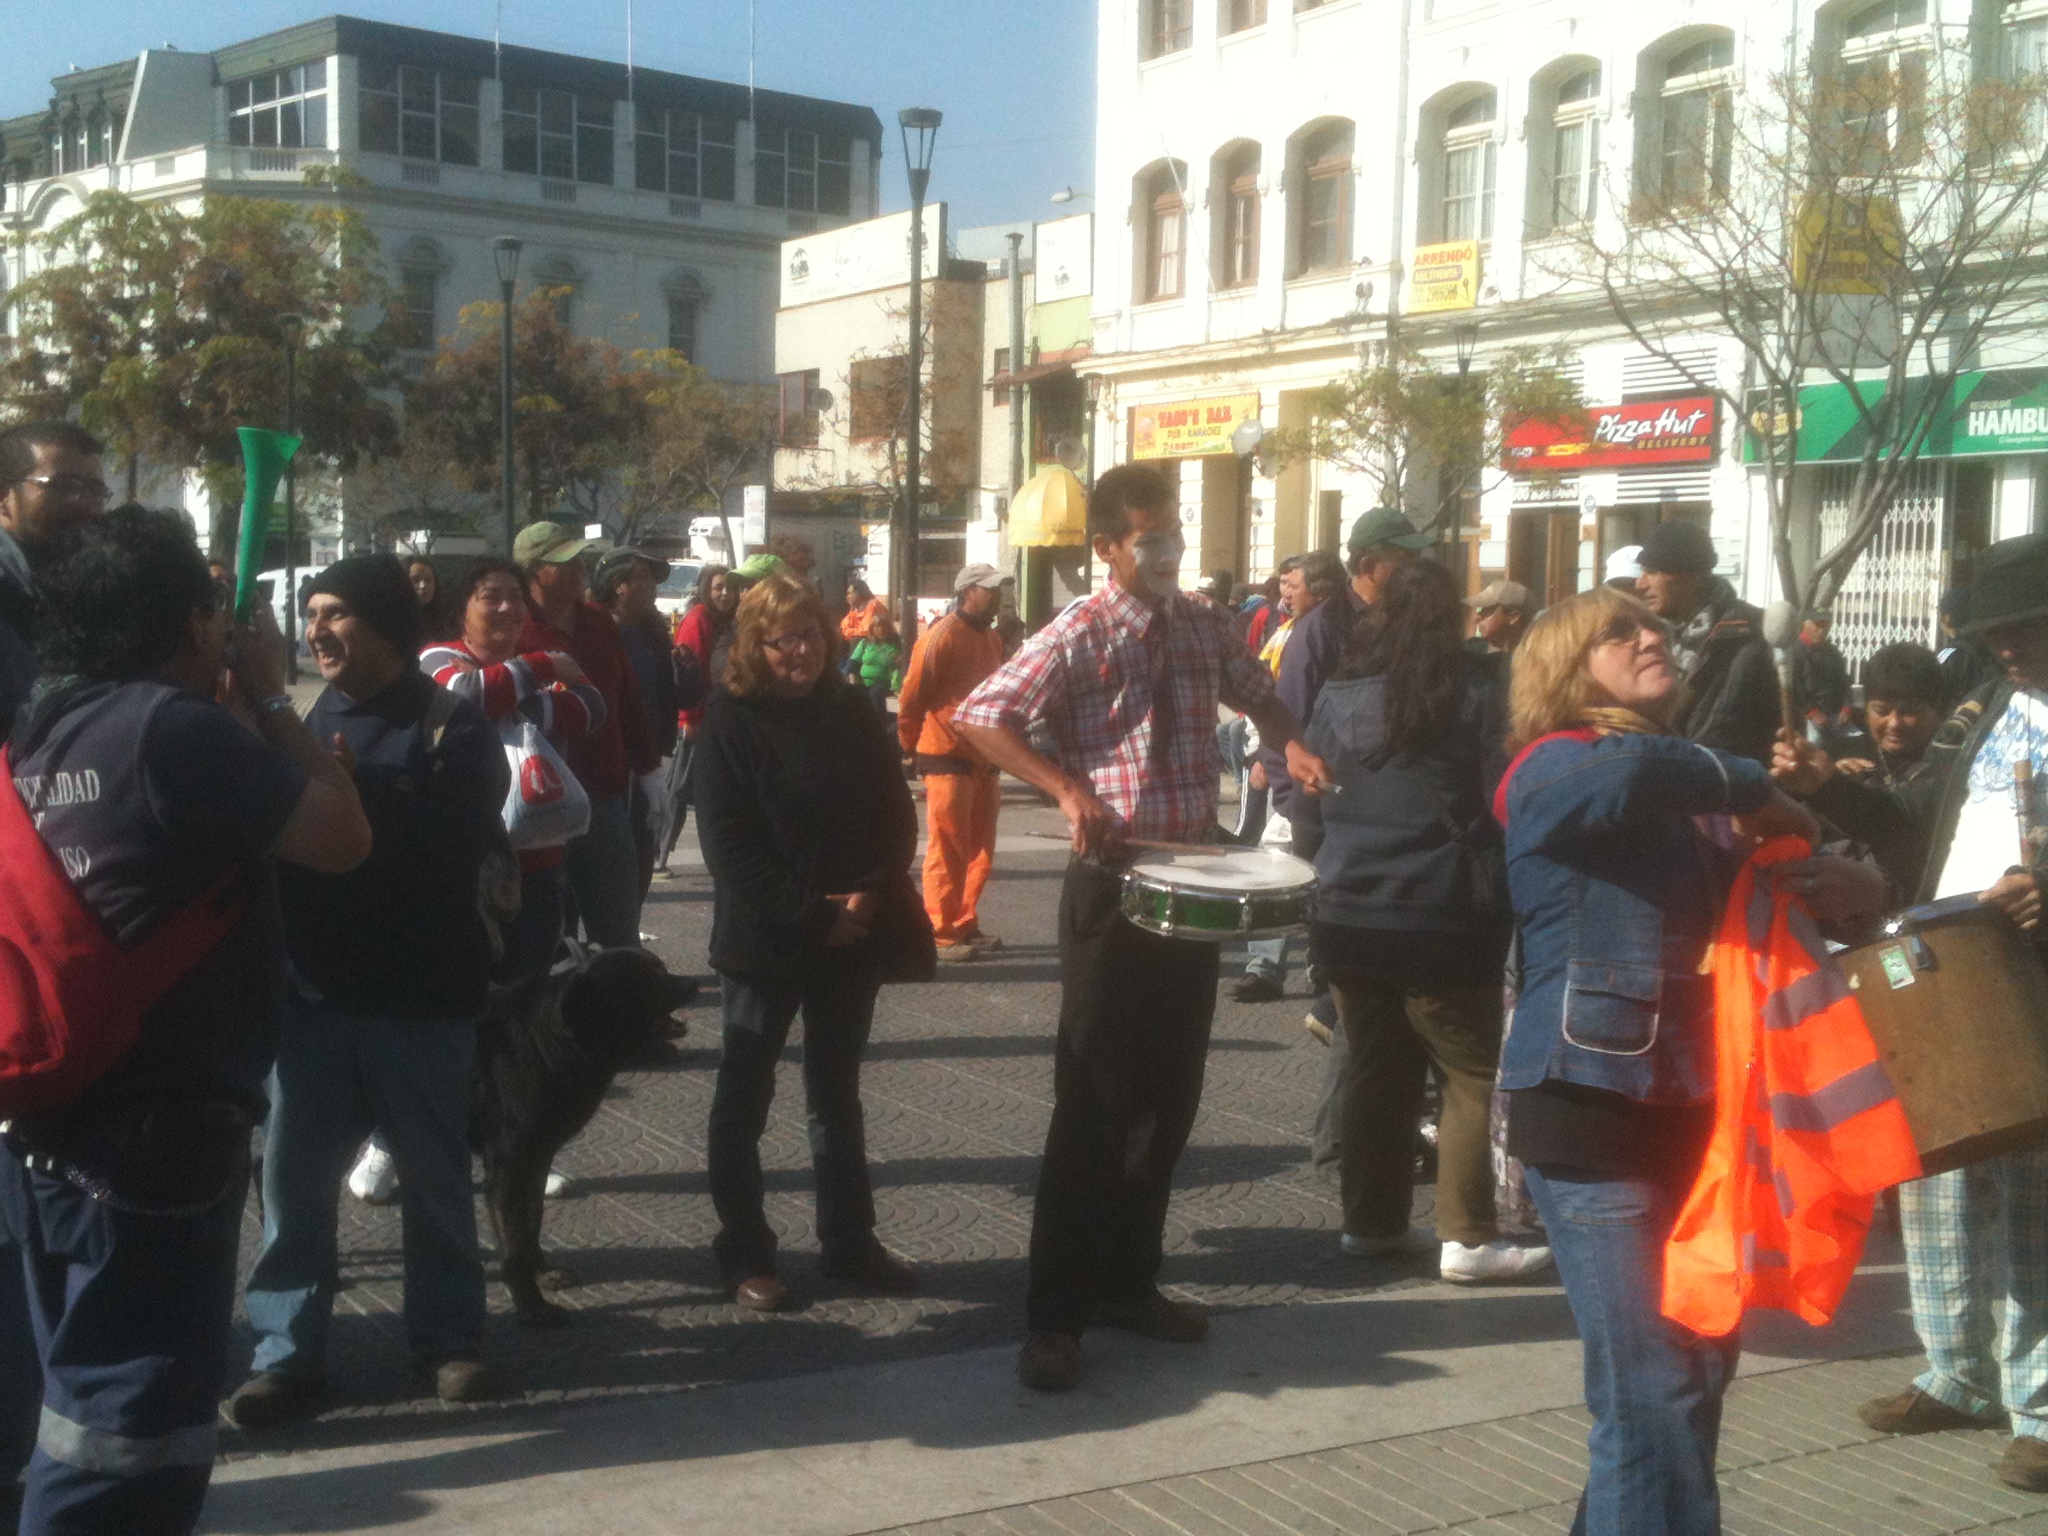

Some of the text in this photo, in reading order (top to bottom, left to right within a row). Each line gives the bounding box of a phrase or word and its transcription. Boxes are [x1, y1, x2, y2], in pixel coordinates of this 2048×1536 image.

[1206, 405, 1233, 424] BAR
[1188, 426, 1222, 437] KARAOKE
[1594, 407, 1707, 442] Pizza Hut
[1638, 436, 1708, 448] DELIVERY
